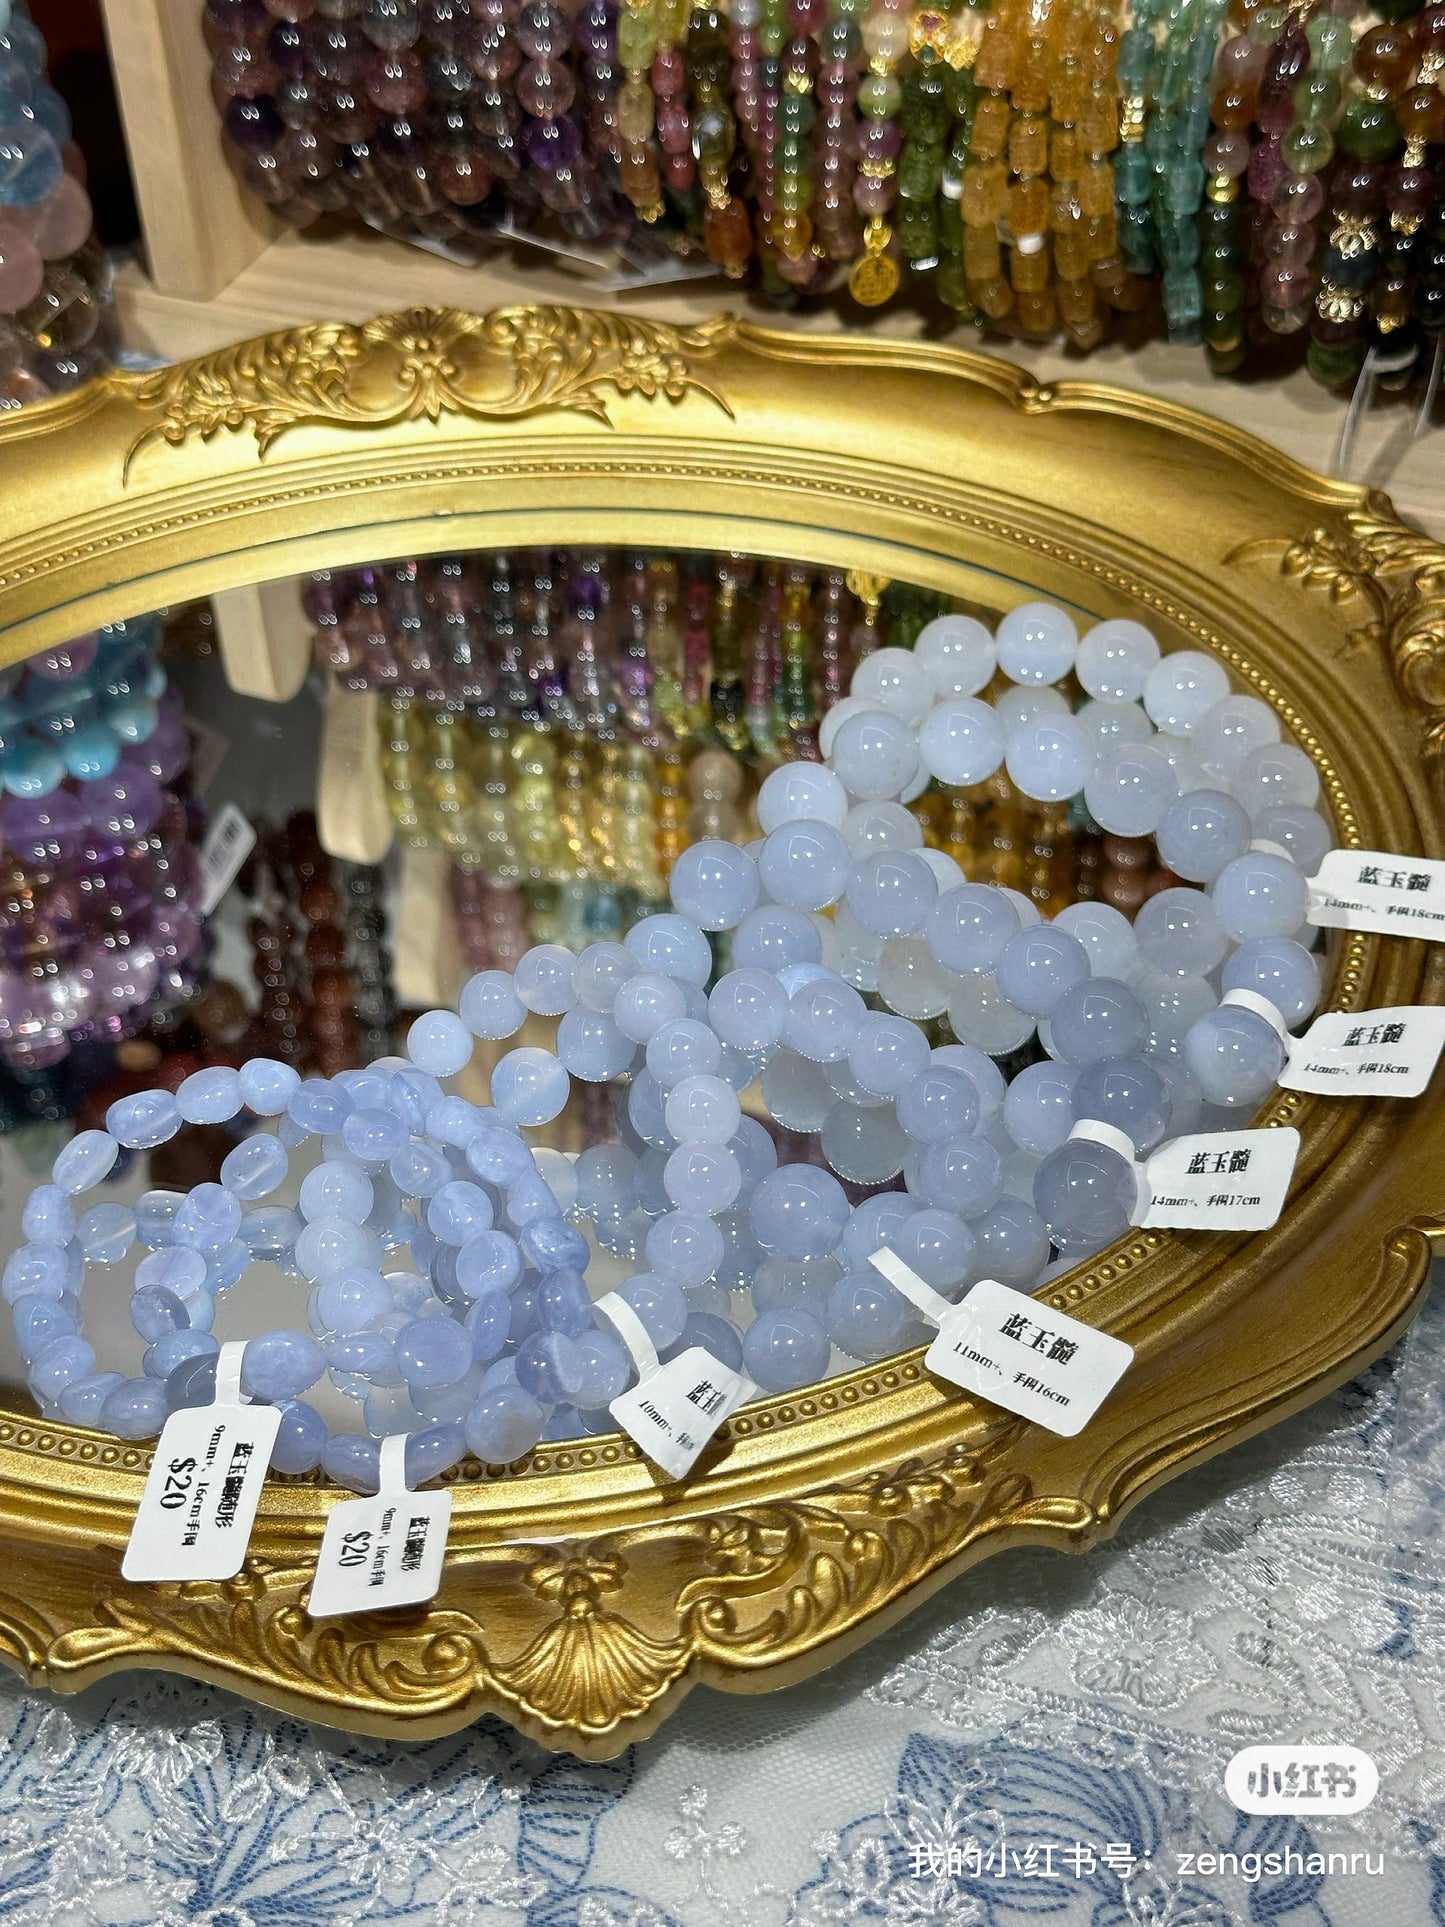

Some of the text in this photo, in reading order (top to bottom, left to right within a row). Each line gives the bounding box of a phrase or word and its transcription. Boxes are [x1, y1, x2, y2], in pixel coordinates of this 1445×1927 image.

[1356, 865, 1432, 892] 蓝玉髓
[1342, 1022, 1407, 1047] 蓝玉髓
[1185, 1149, 1251, 1174] 蓝玉髓
[998, 1312, 1080, 1366] 蓝玉髓
[159, 1456, 199, 1510] $20
[338, 1530, 375, 1568] $20
